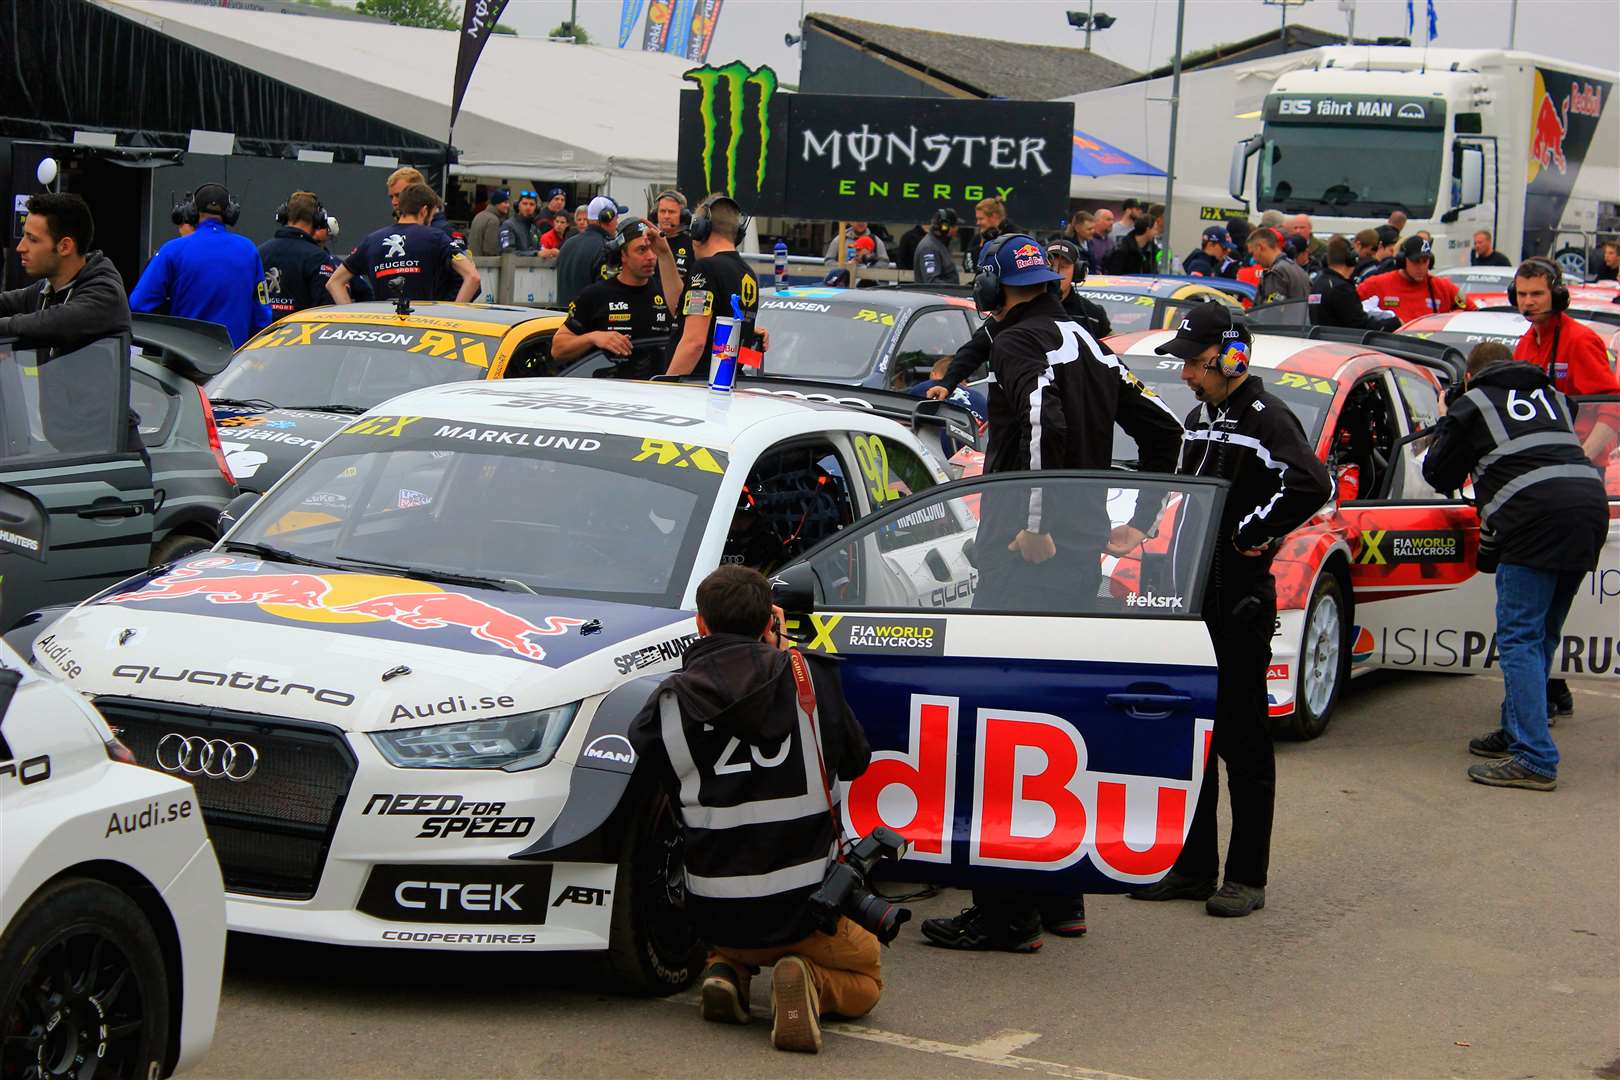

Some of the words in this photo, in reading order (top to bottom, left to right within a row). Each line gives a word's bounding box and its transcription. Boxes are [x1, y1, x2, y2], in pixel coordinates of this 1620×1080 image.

[1317, 100, 1352, 116] fährt
[1357, 102, 1392, 117] MAN
[802, 124, 1052, 176] MONSTER
[839, 180, 1014, 202] ENERGY
[374, 259, 421, 272] PEUGEOT
[760, 300, 831, 313] HANSEN
[318, 329, 414, 346] LARSSON
[1156, 360, 1185, 370] ST
[1506, 388, 1557, 421] 61
[434, 425, 601, 452] MARKLUND
[854, 434, 900, 503] 92
[1393, 546, 1456, 556] RALLYCROSS
[1126, 591, 1183, 608] #eksrx
[849, 636, 933, 648] RALLYCROSS
[37, 634, 83, 680] Audi.se
[791, 654, 805, 682] Canon
[113, 663, 356, 707] quattro
[389, 693, 514, 724] Audi.se
[586, 748, 632, 763] MAN
[361, 794, 463, 815] NEED
[456, 802, 506, 816] FOR
[104, 800, 192, 839] Audi.se
[415, 816, 536, 839] SPEED
[394, 880, 525, 911] CTEK
[551, 885, 611, 907] ABT
